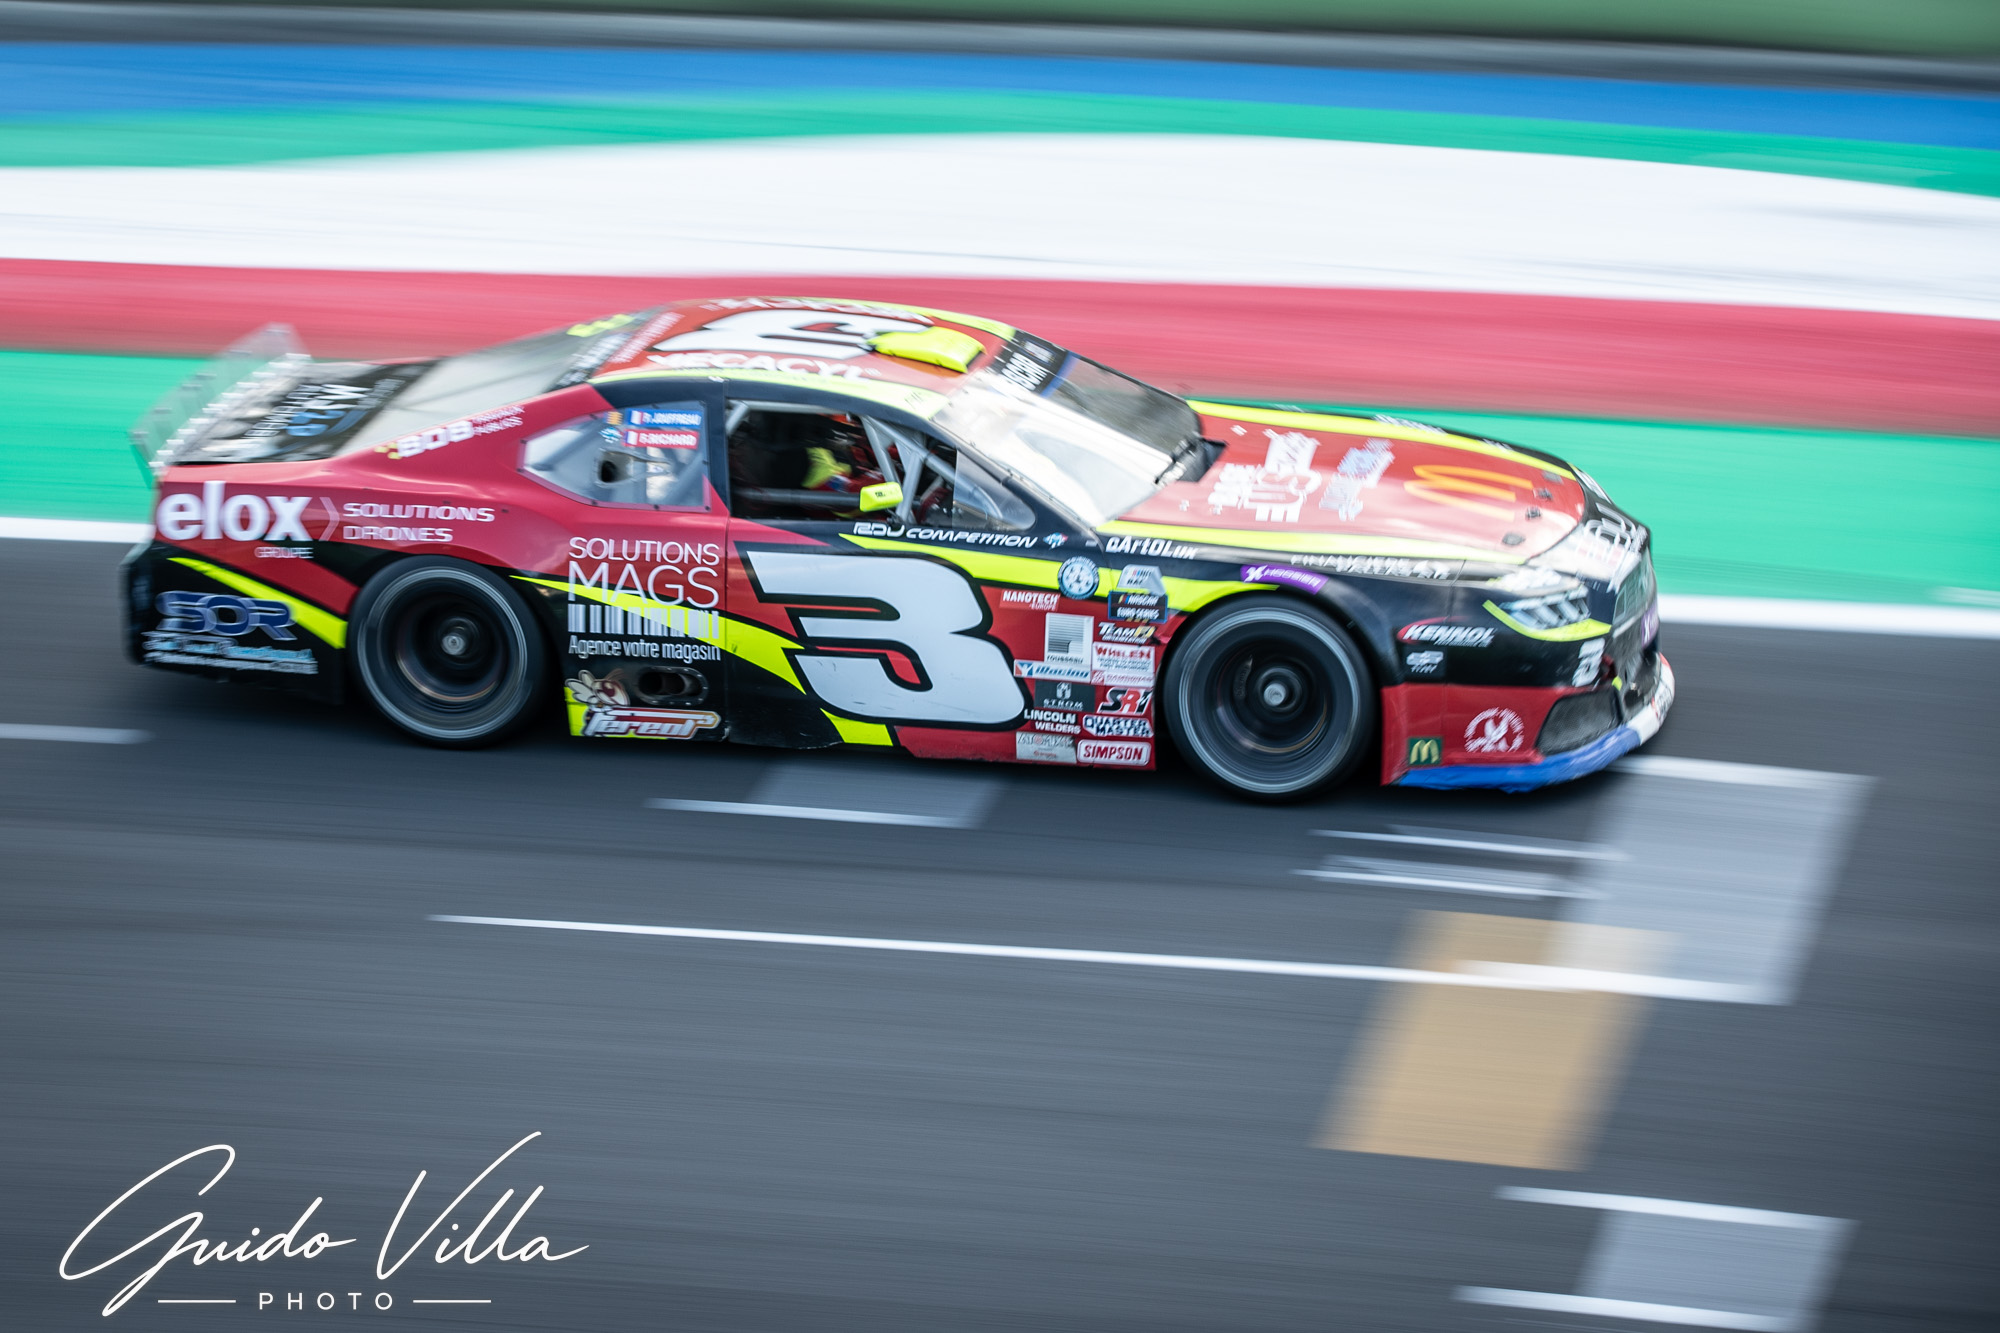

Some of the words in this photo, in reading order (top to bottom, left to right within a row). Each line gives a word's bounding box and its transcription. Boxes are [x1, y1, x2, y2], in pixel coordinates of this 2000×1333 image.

[156, 480, 314, 542] elox
[342, 502, 496, 522] SOLUTIONS
[342, 525, 454, 543] DRONES
[905, 527, 1038, 549] COMPETITION
[568, 536, 720, 566] SOLUTIONS
[568, 560, 720, 609] MAGS
[1002, 590, 1059, 604] NANOTECH
[745, 550, 1025, 725] 3
[568, 634, 622, 660] Agence
[622, 638, 661, 659] votre
[661, 640, 722, 665] magasin
[1023, 709, 1077, 725] LINCOLN
[1034, 721, 1082, 735] WELDERS
[1083, 744, 1144, 761] SIMPSON
